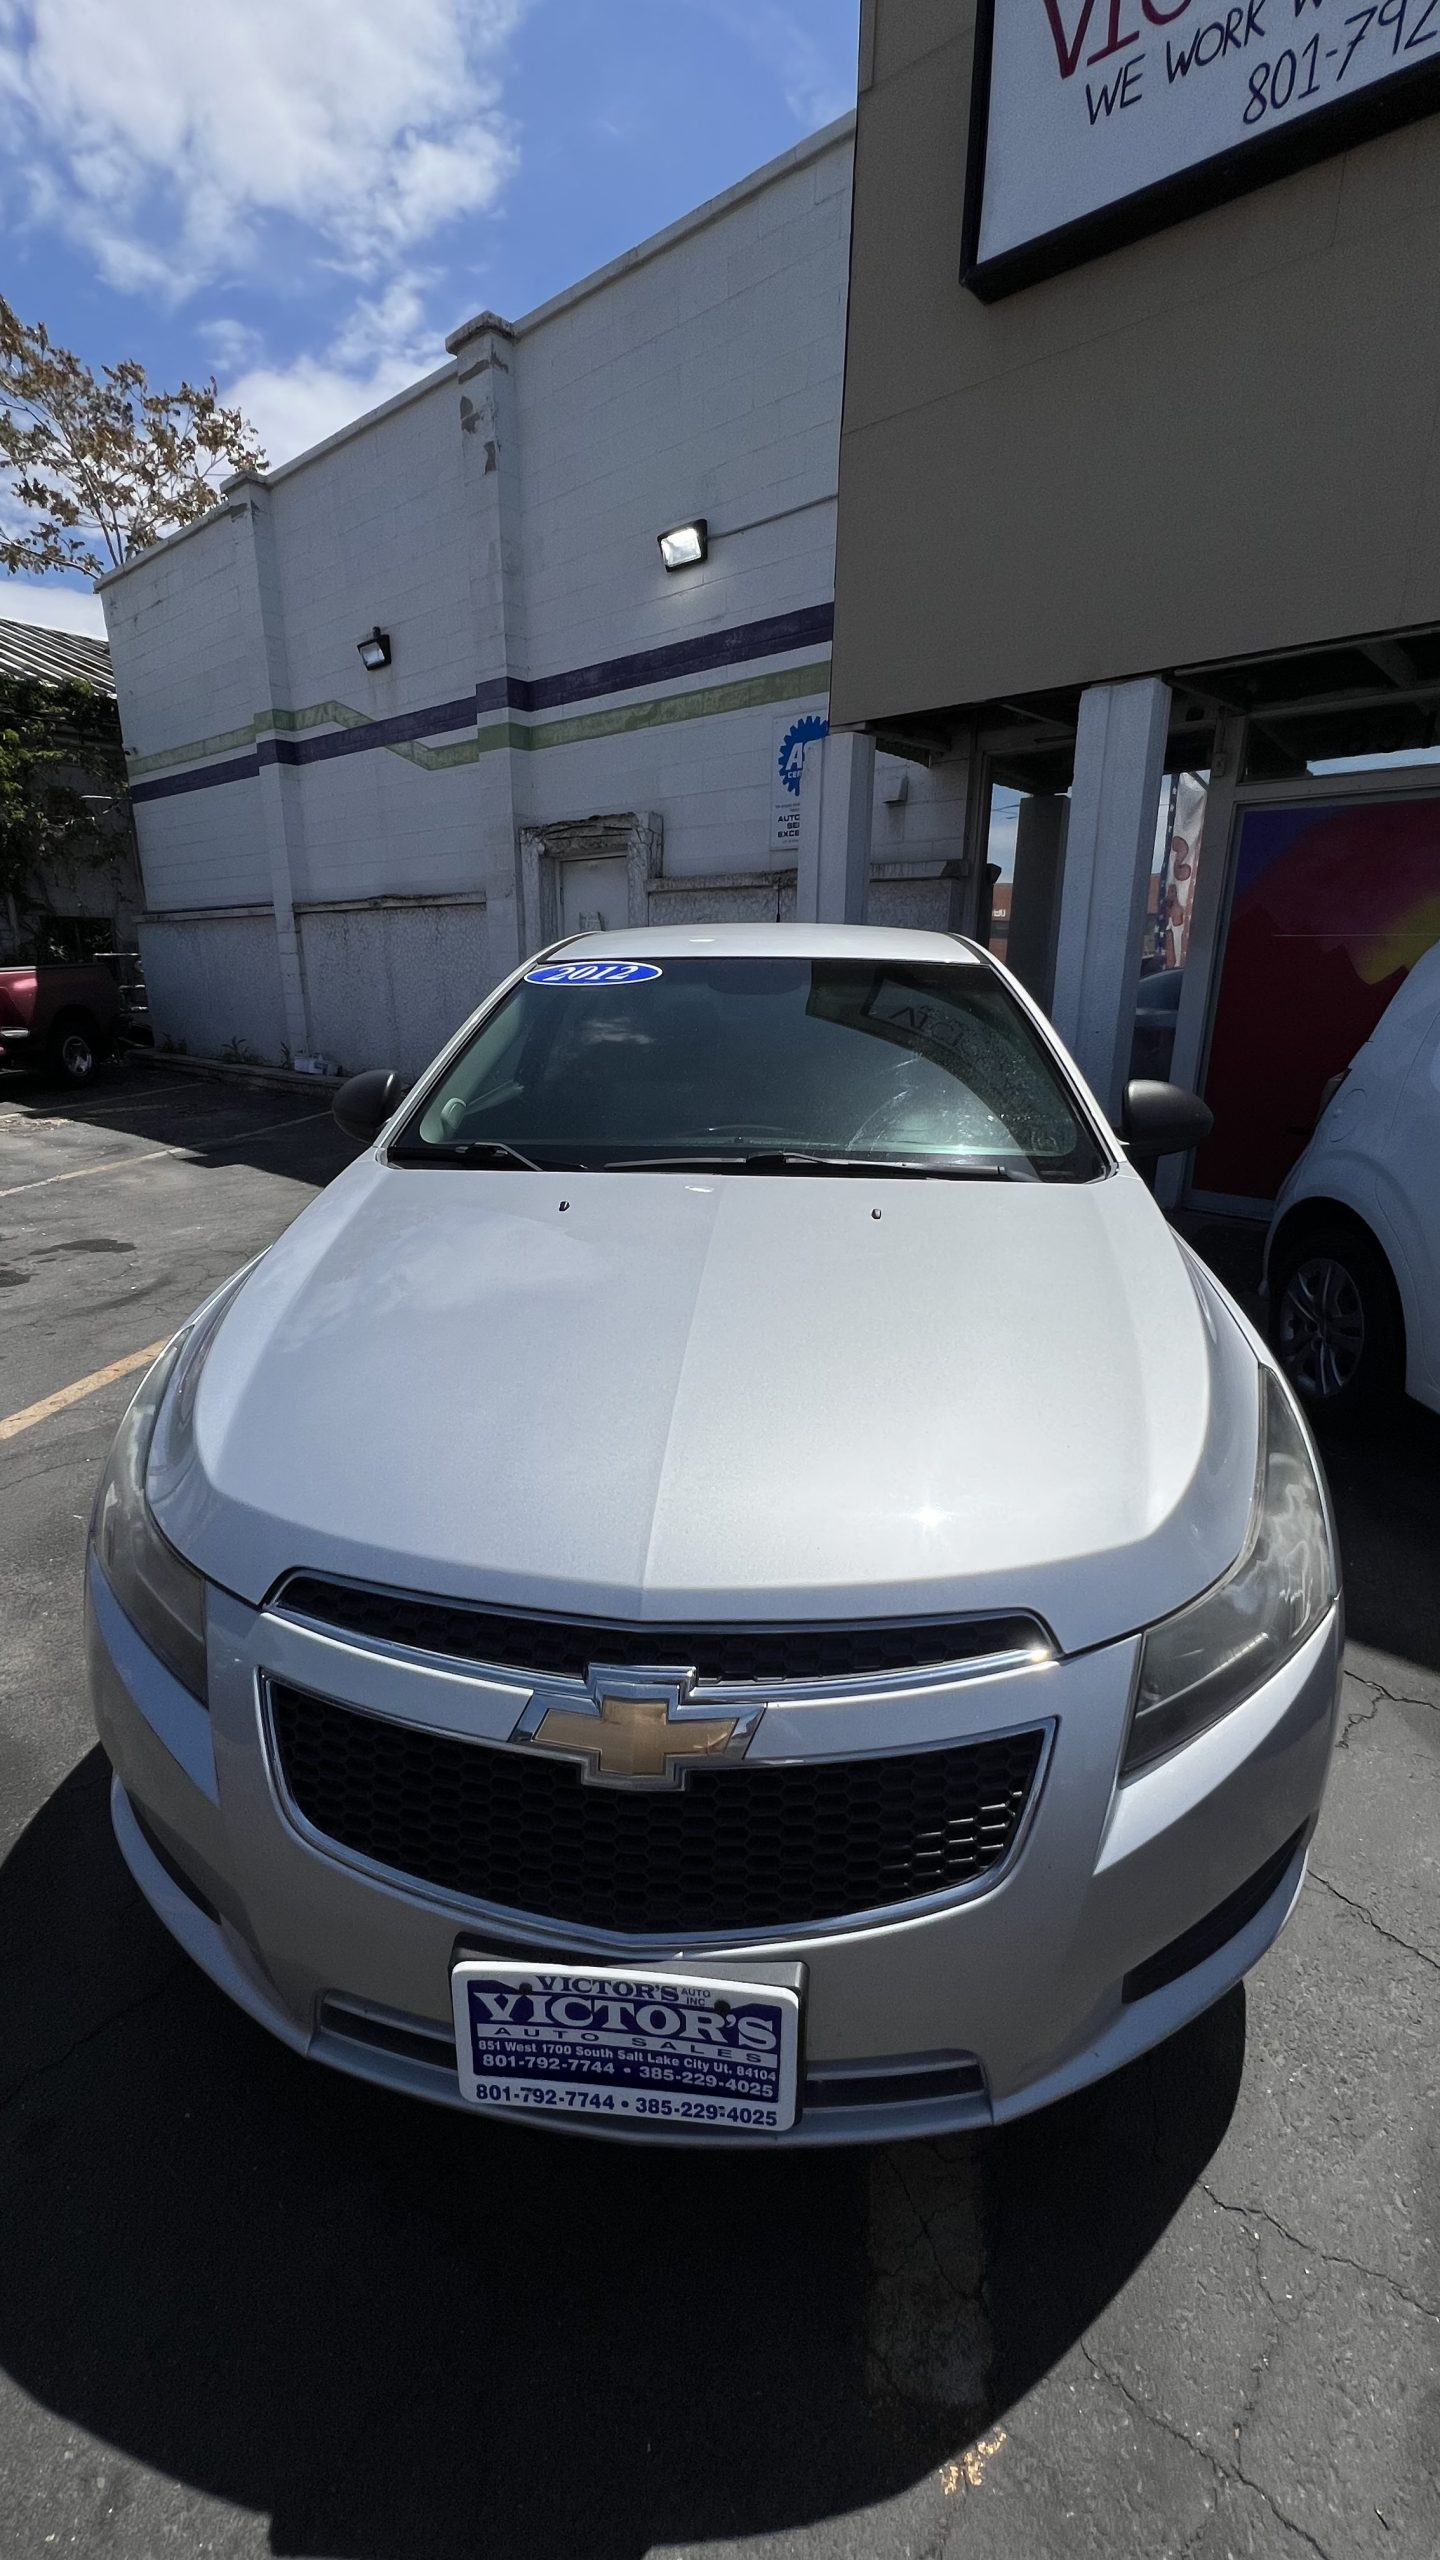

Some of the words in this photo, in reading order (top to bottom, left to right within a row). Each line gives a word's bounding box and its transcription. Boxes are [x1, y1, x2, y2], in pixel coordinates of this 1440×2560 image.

[1085, 53, 1147, 126] WE
[1166, 0, 1266, 85] WORK
[542, 965, 639, 981] 2012
[536, 1975, 680, 2001] VICTOR'S
[681, 1986, 711, 1998] AUTO
[686, 1996, 706, 2006] INC
[473, 1992, 777, 2050] VICTOR'S
[478, 2040, 500, 2051] 851
[504, 2041, 537, 2053] West
[542, 2044, 572, 2055] 1700
[575, 2046, 614, 2059] South
[617, 2049, 644, 2062] Salt
[647, 2053, 680, 2066] Lake
[683, 2058, 710, 2073] City
[713, 2061, 733, 2075] Ut.
[736, 2066, 777, 2082] 84104
[494, 2027, 600, 2042] AUTO
[631, 2037, 762, 2063] SALES
[482, 2053, 616, 2075] 801-792-7744
[639, 2065, 774, 2098] 385-229-4025
[476, 2083, 615, 2111] 801-792-7744
[635, 2097, 778, 2127] 385-229-4025
